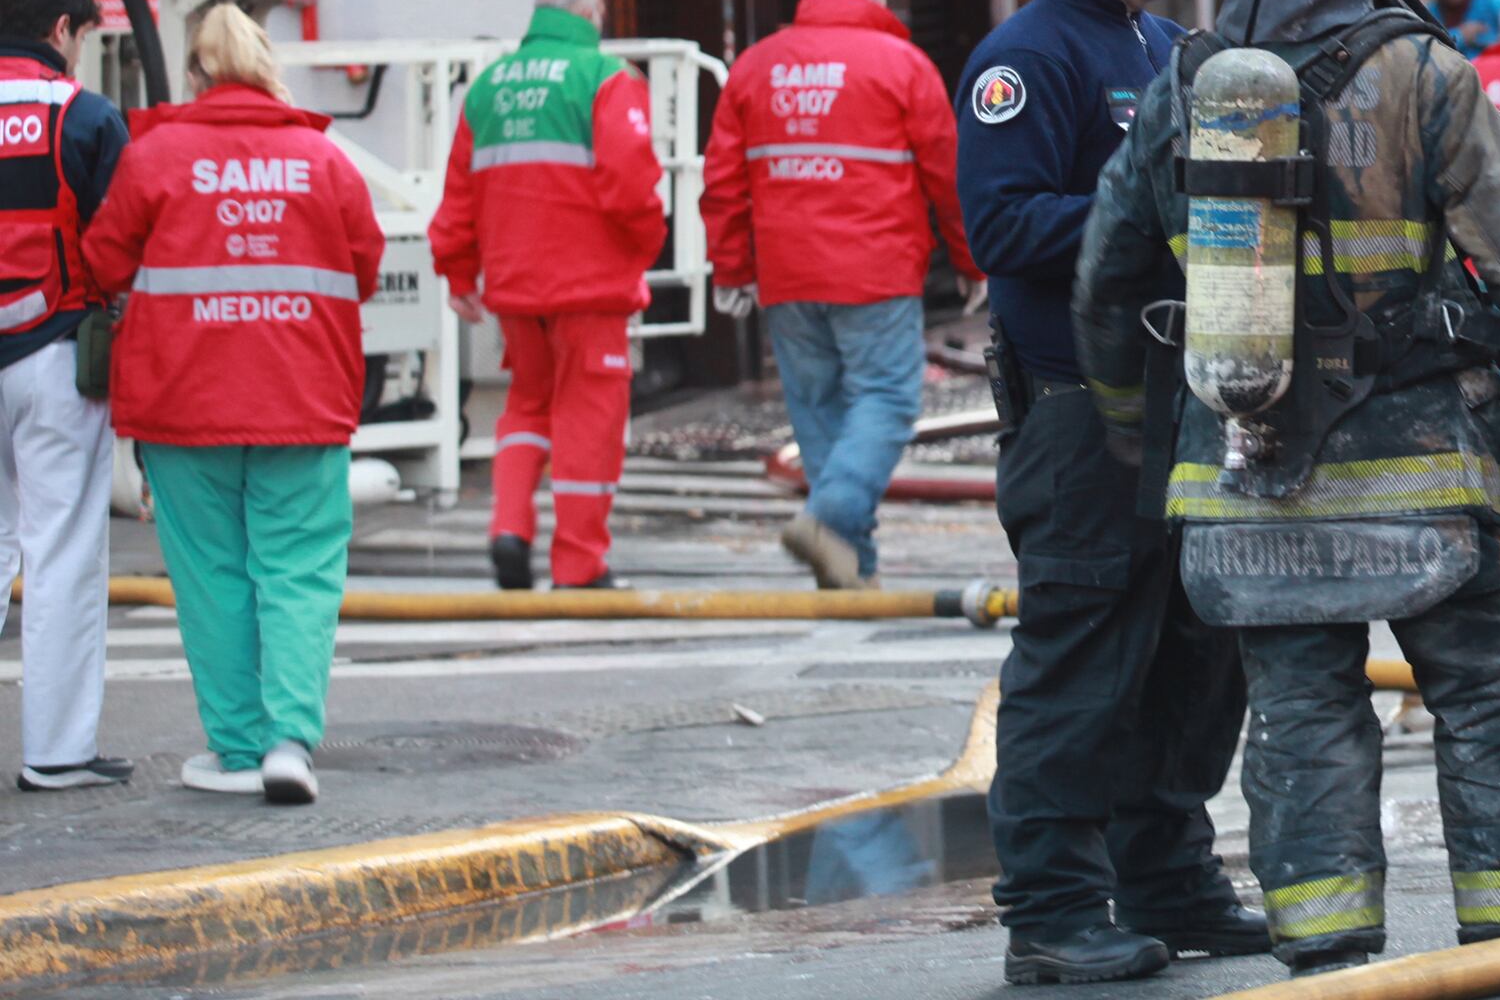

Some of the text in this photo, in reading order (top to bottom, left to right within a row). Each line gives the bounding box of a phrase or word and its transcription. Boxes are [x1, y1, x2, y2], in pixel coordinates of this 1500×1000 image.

[491, 58, 570, 86] SAME
[769, 62, 847, 88] SAME
[515, 87, 549, 112] 107
[795, 88, 838, 116] 107
[192, 158, 311, 194] SAME
[768, 156, 845, 181] MEDICO
[244, 199, 287, 223] 107
[193, 296, 312, 322] MEDICO
[1331, 526, 1443, 577] PABLO
